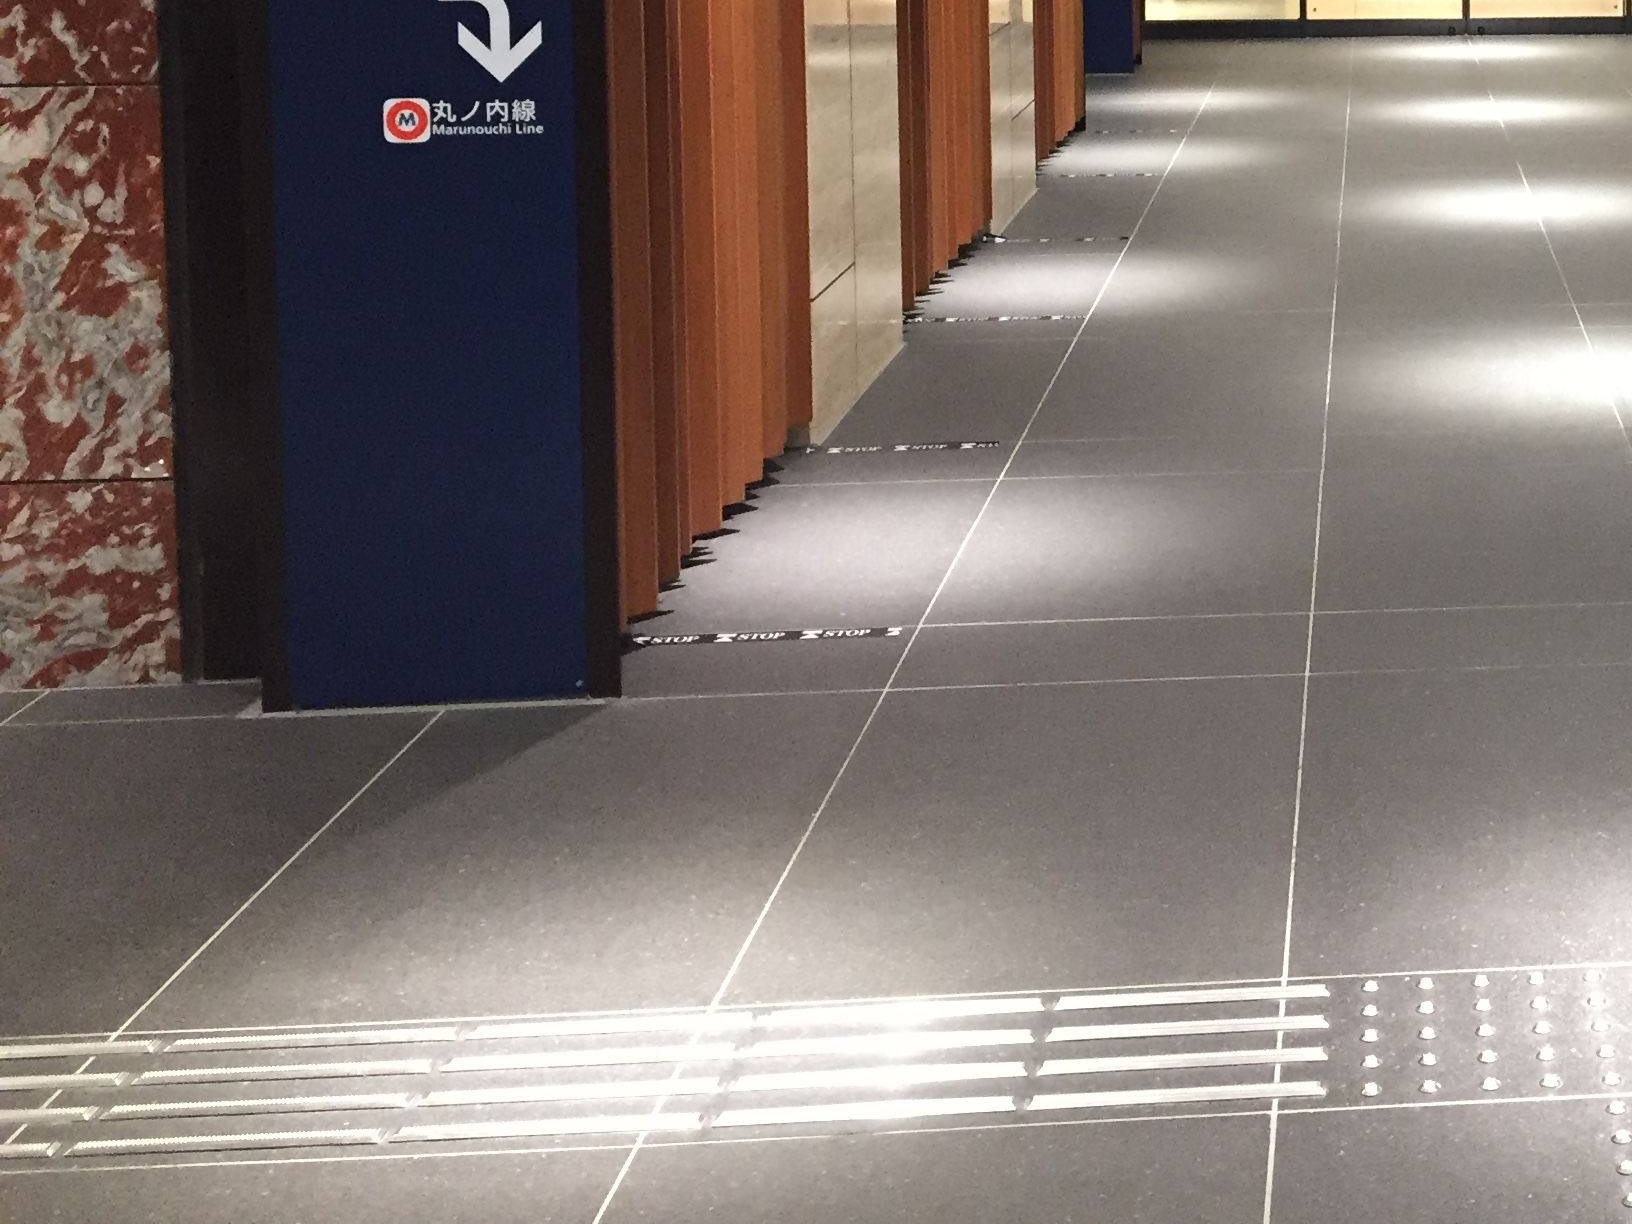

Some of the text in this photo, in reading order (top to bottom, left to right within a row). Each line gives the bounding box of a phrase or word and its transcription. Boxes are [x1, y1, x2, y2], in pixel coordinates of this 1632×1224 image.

[398, 99, 537, 127] M 丸ノ内線
[432, 123, 544, 135] Marunouchi Line
[737, 631, 786, 641] STOP
[823, 628, 871, 637] STOP
